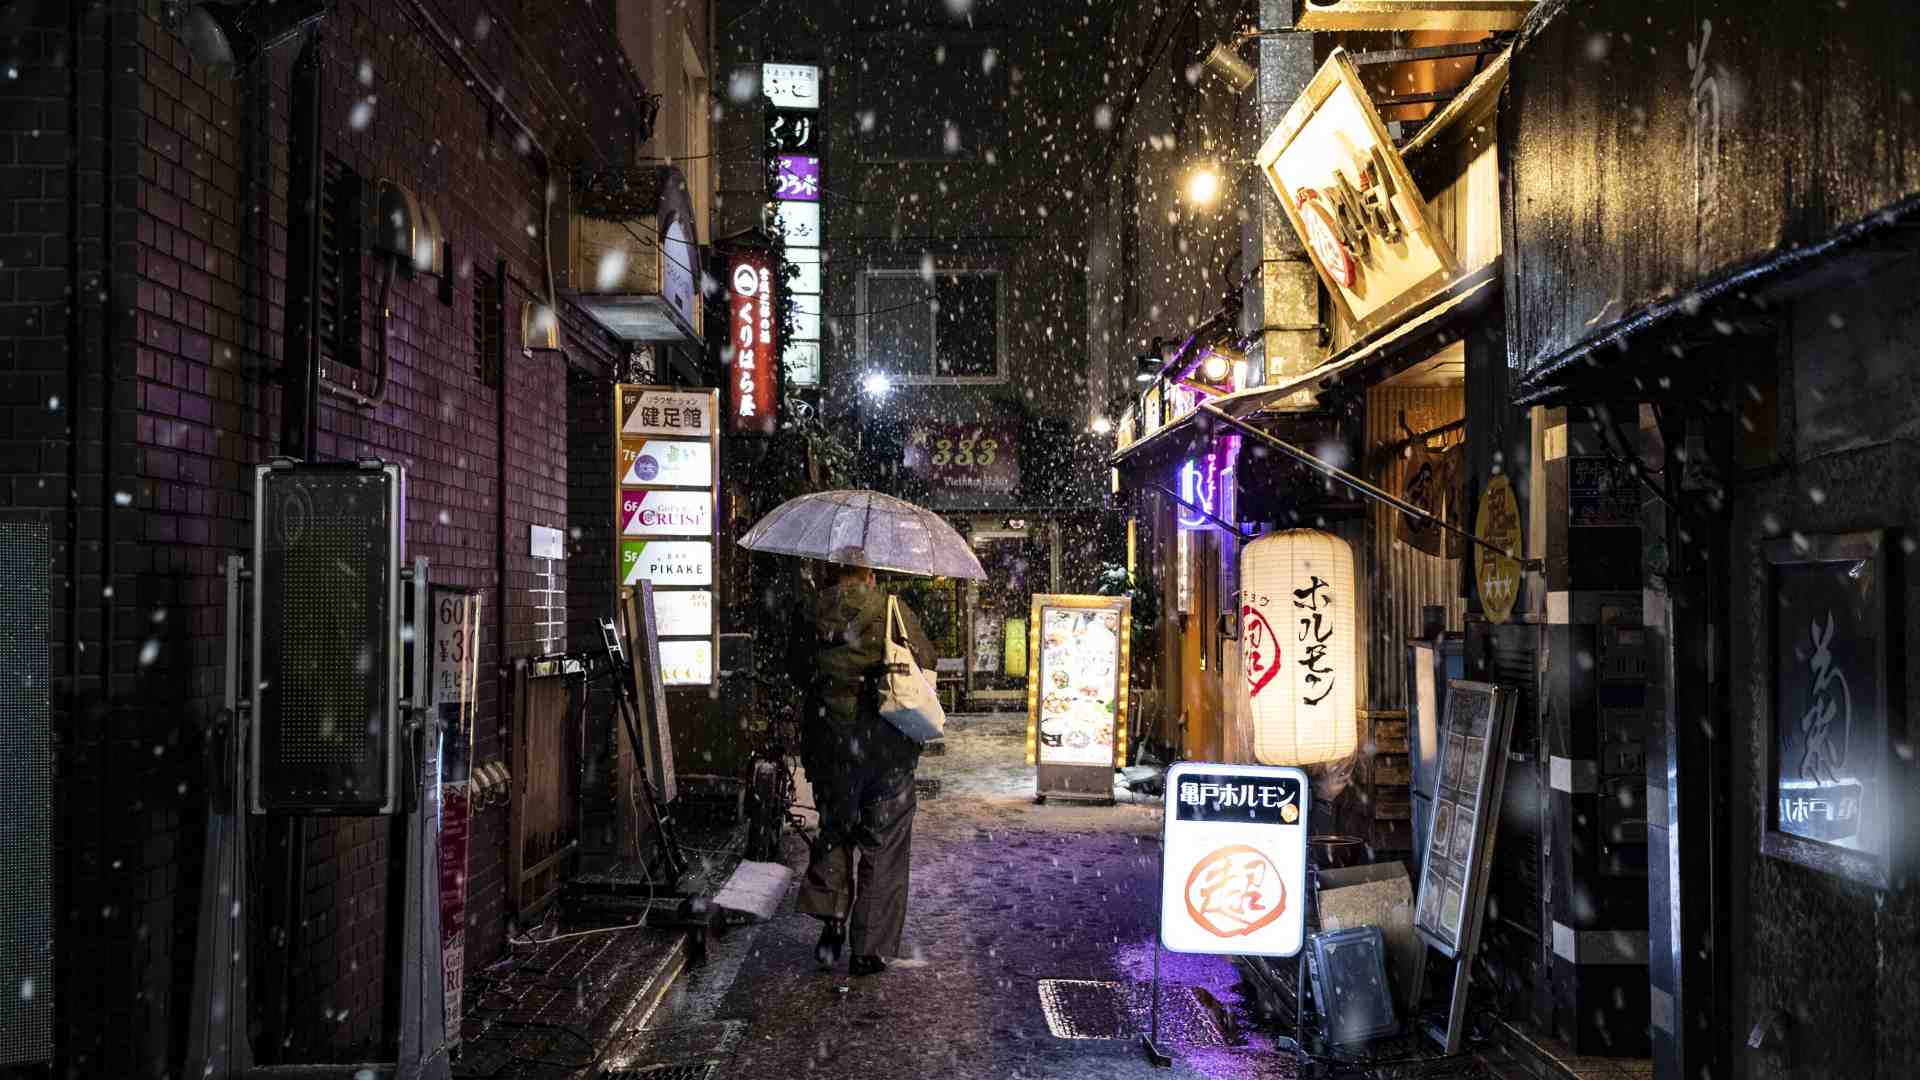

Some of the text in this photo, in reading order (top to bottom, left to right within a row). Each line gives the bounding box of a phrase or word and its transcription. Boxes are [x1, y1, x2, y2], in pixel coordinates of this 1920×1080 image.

[624, 395, 636, 405] 9F
[641, 406, 703, 429] 健足館
[623, 449, 637, 461] 7F
[932, 439, 999, 466] 333
[624, 500, 638, 512] 6F
[624, 550, 638, 562] 5F
[650, 563, 704, 575] PIKAKE
[1293, 575, 1336, 706] ホルモン
[1180, 781, 1296, 809] 亀戸ホルモン
